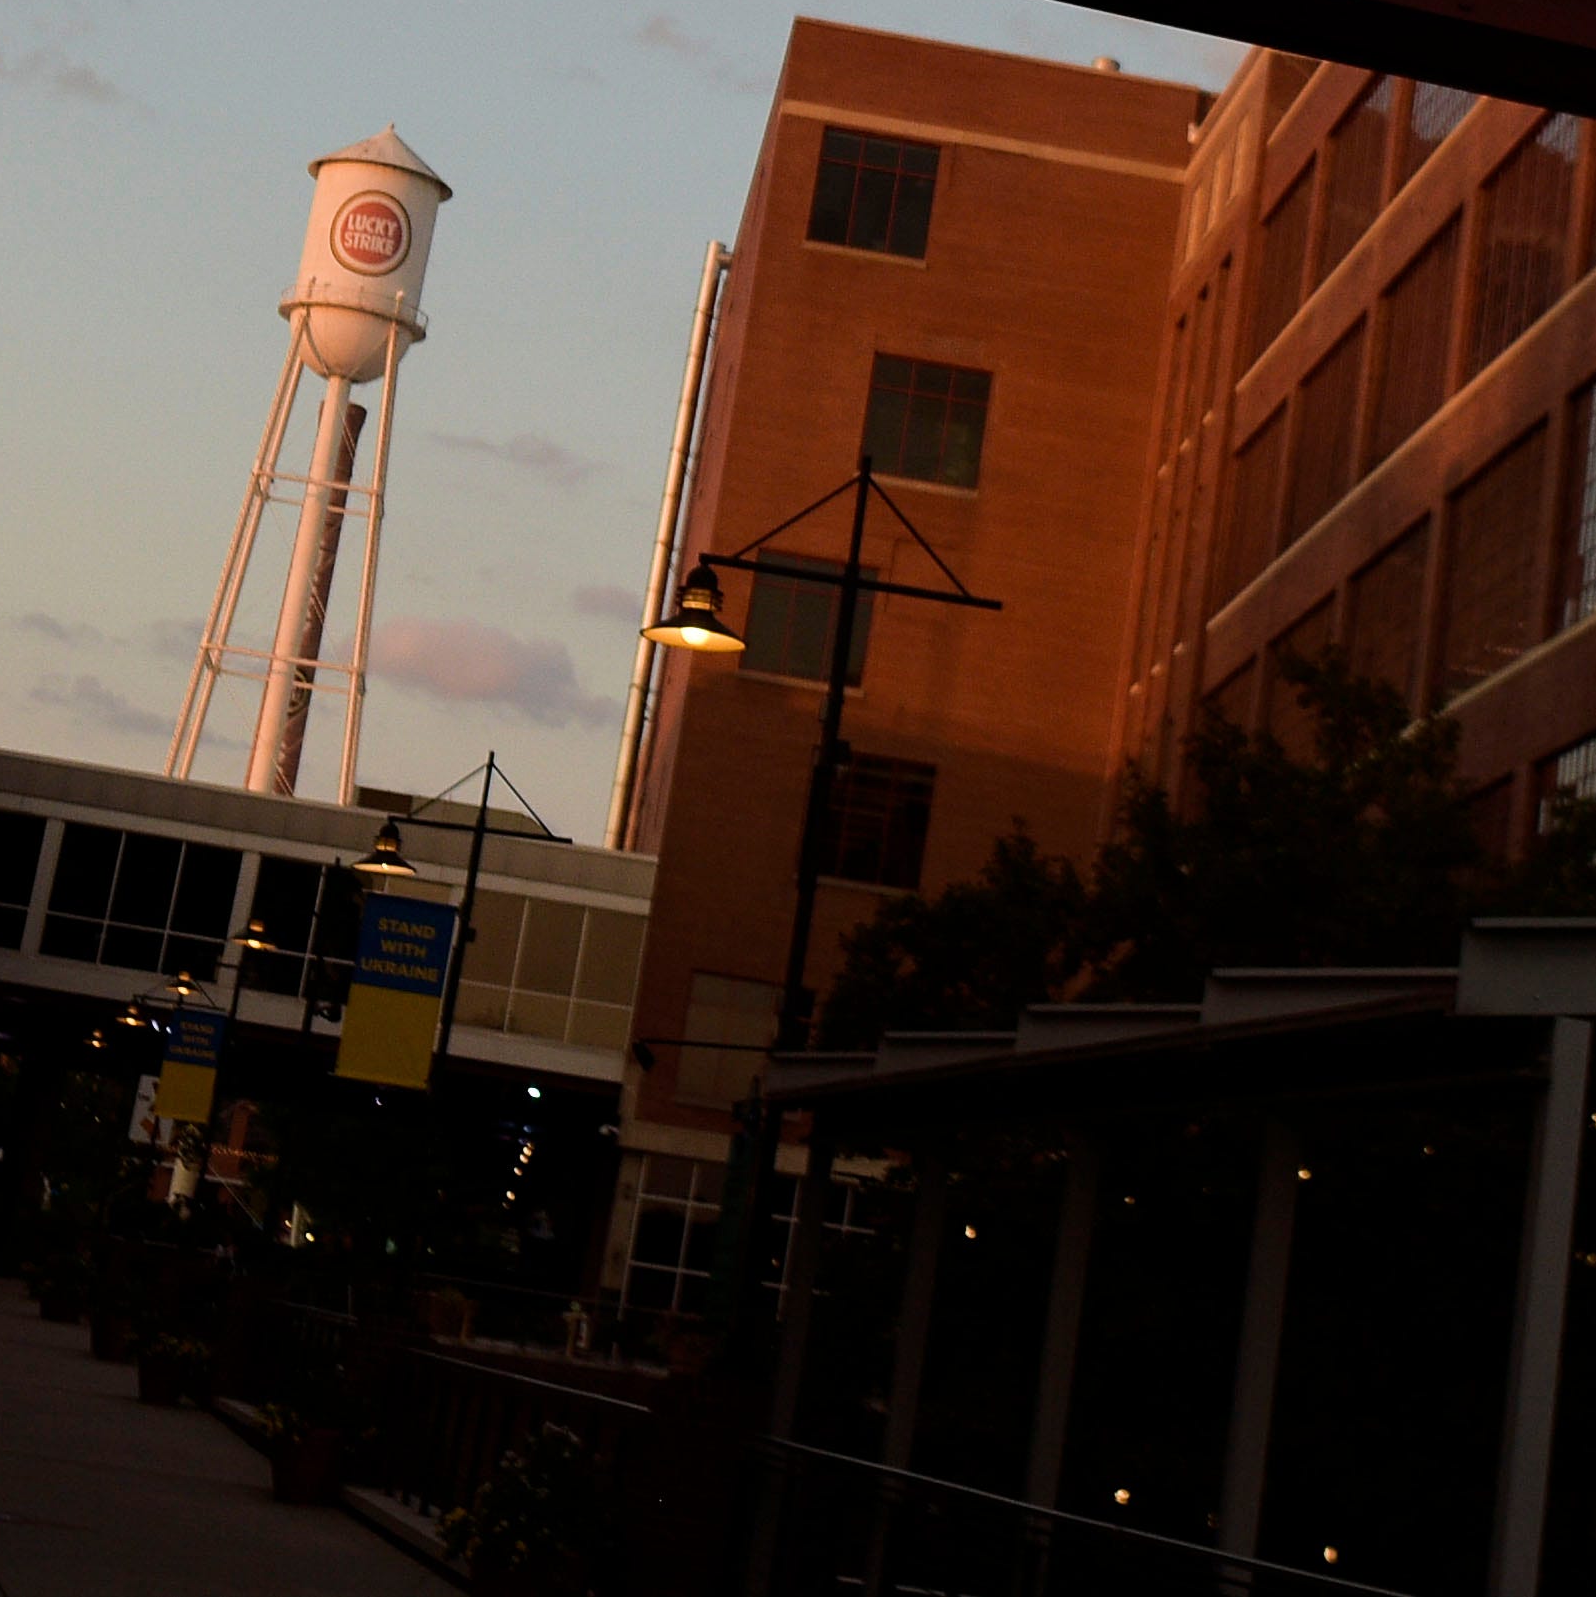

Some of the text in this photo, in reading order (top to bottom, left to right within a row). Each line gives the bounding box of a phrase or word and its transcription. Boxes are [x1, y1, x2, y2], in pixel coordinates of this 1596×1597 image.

[347, 214, 398, 237] LUCKY
[344, 233, 394, 256] STRIKE
[377, 916, 436, 940] STAND
[380, 937, 428, 959] WITH
[359, 956, 440, 983] UKRAINE
